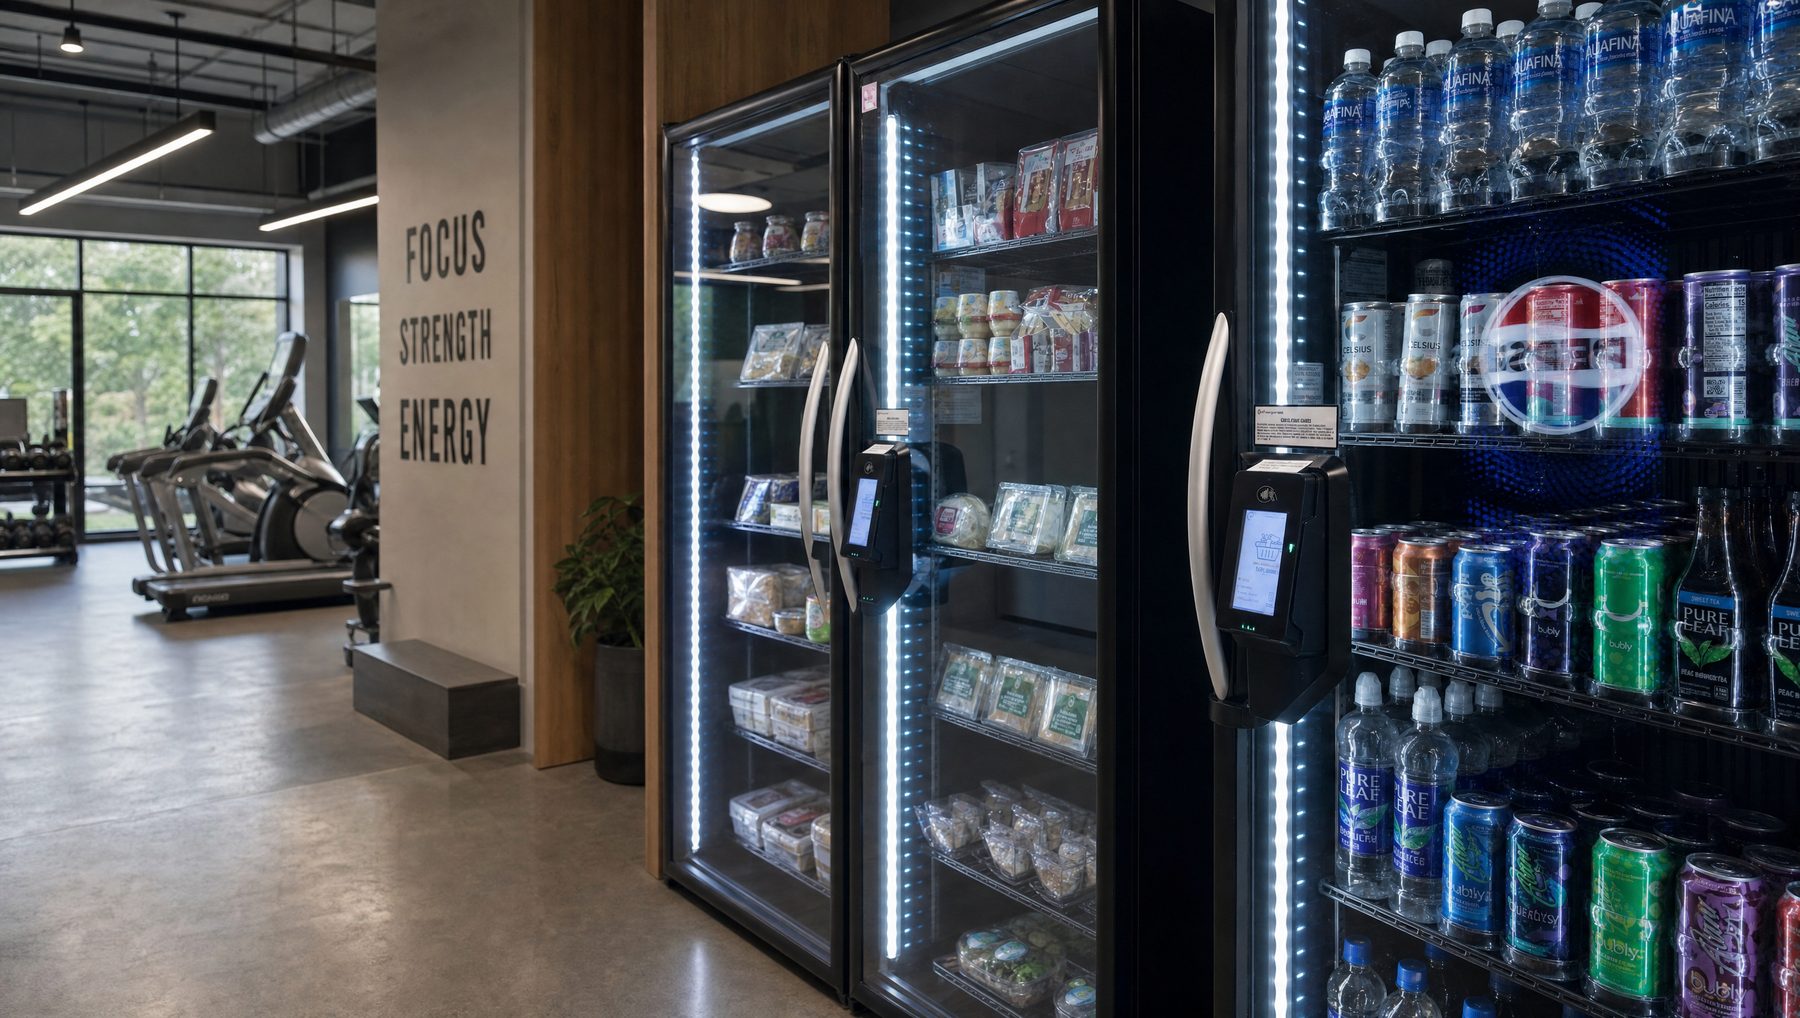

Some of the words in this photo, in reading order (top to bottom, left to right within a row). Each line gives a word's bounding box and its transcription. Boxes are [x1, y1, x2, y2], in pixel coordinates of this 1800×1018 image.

[406, 210, 486, 284] FOCUS
[400, 308, 491, 366] STRENGTH
[1407, 340, 1441, 350] CELSIUS
[1343, 345, 1372, 354] CELSIUS
[400, 398, 491, 465] ENERGY
[1683, 607, 1729, 625] PURE
[1537, 625, 1561, 638] bubly
[1683, 619, 1728, 637] LEAF
[1609, 640, 1633, 652] bubly
[1340, 767, 1380, 788] PURE
[1691, 970, 1747, 1005] bubly
